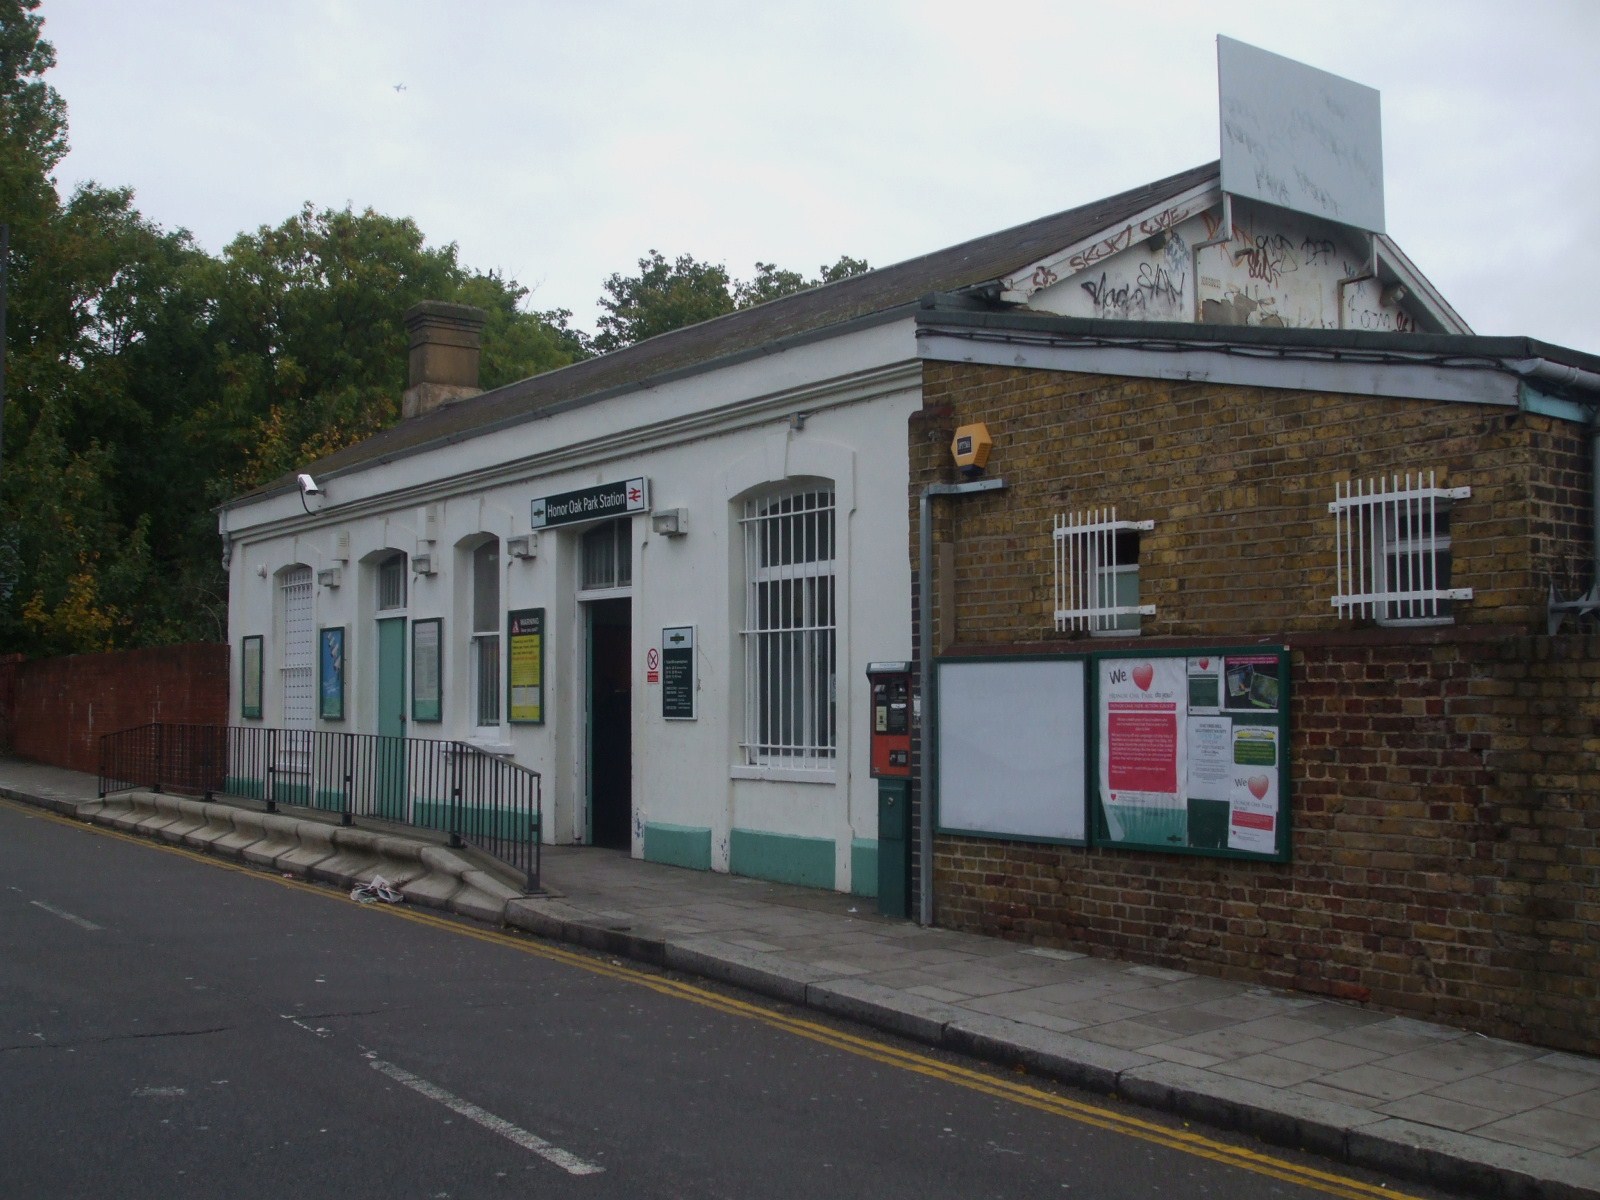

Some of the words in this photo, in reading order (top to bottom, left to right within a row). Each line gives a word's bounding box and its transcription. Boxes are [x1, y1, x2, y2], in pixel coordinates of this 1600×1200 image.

[547, 505, 568, 518] Honor
[568, 500, 581, 514] Oak
[583, 496, 599, 511] Park
[599, 491, 626, 508] Station
[1109, 669, 1127, 685] We
[1234, 778, 1247, 788] We
